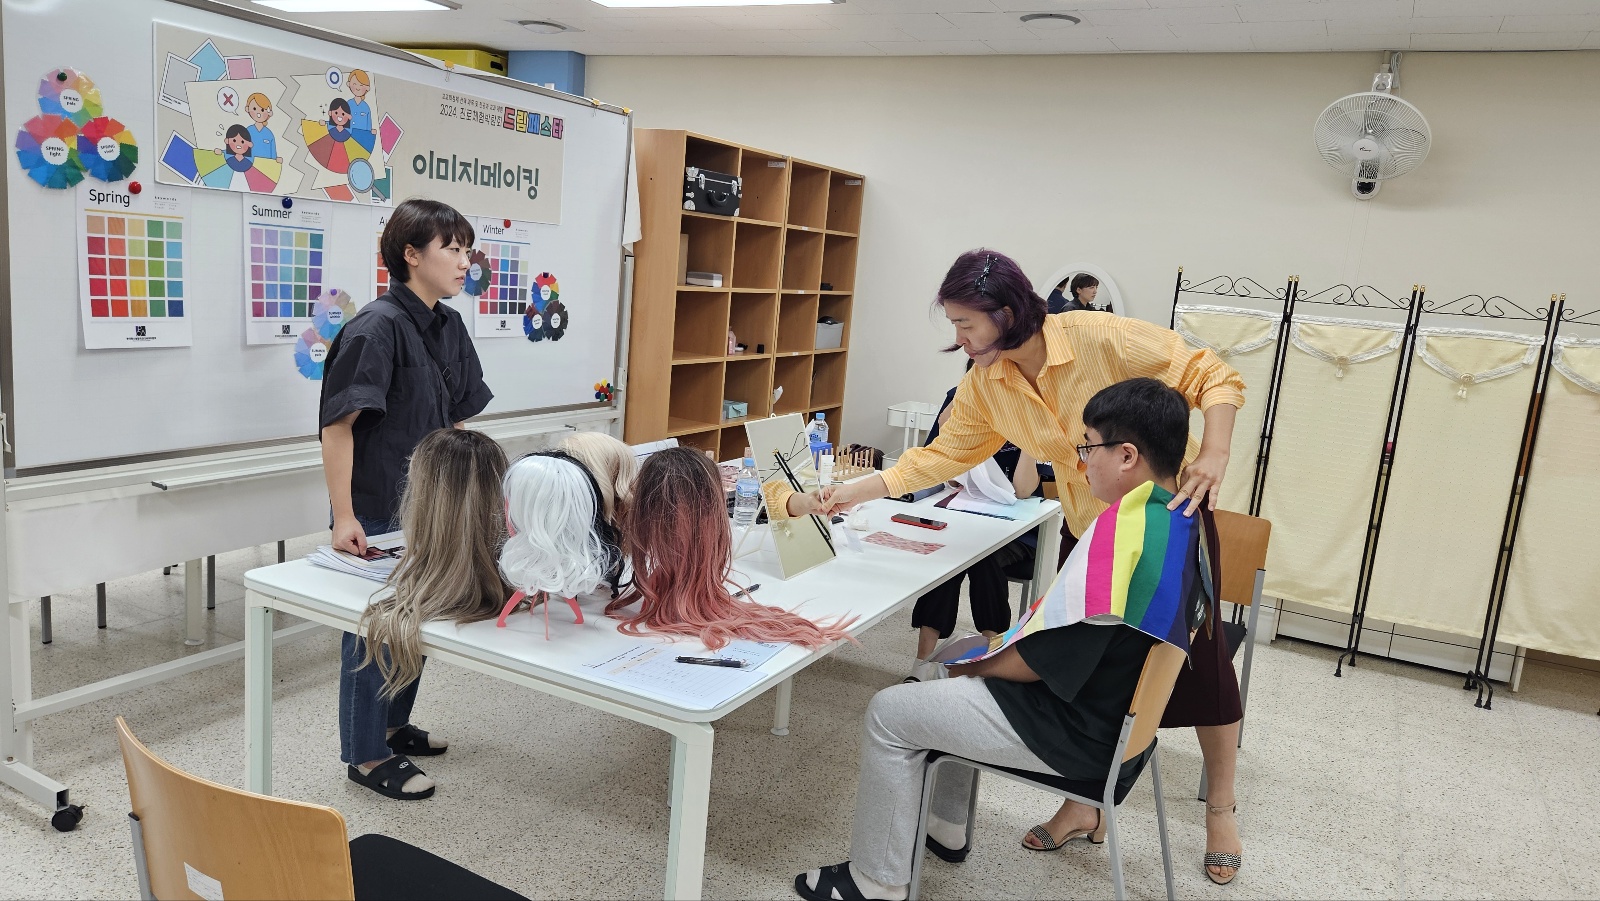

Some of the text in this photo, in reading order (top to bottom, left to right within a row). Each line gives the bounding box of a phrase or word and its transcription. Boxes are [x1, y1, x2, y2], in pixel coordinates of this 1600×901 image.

[460, 107, 502, 127] 진로체험박람회
[503, 106, 563, 140] 드림페스타
[412, 150, 539, 200] 이미지메이킹
[89, 188, 130, 208] Spring
[251, 204, 293, 220] Summer
[482, 224, 505, 235] Winter
